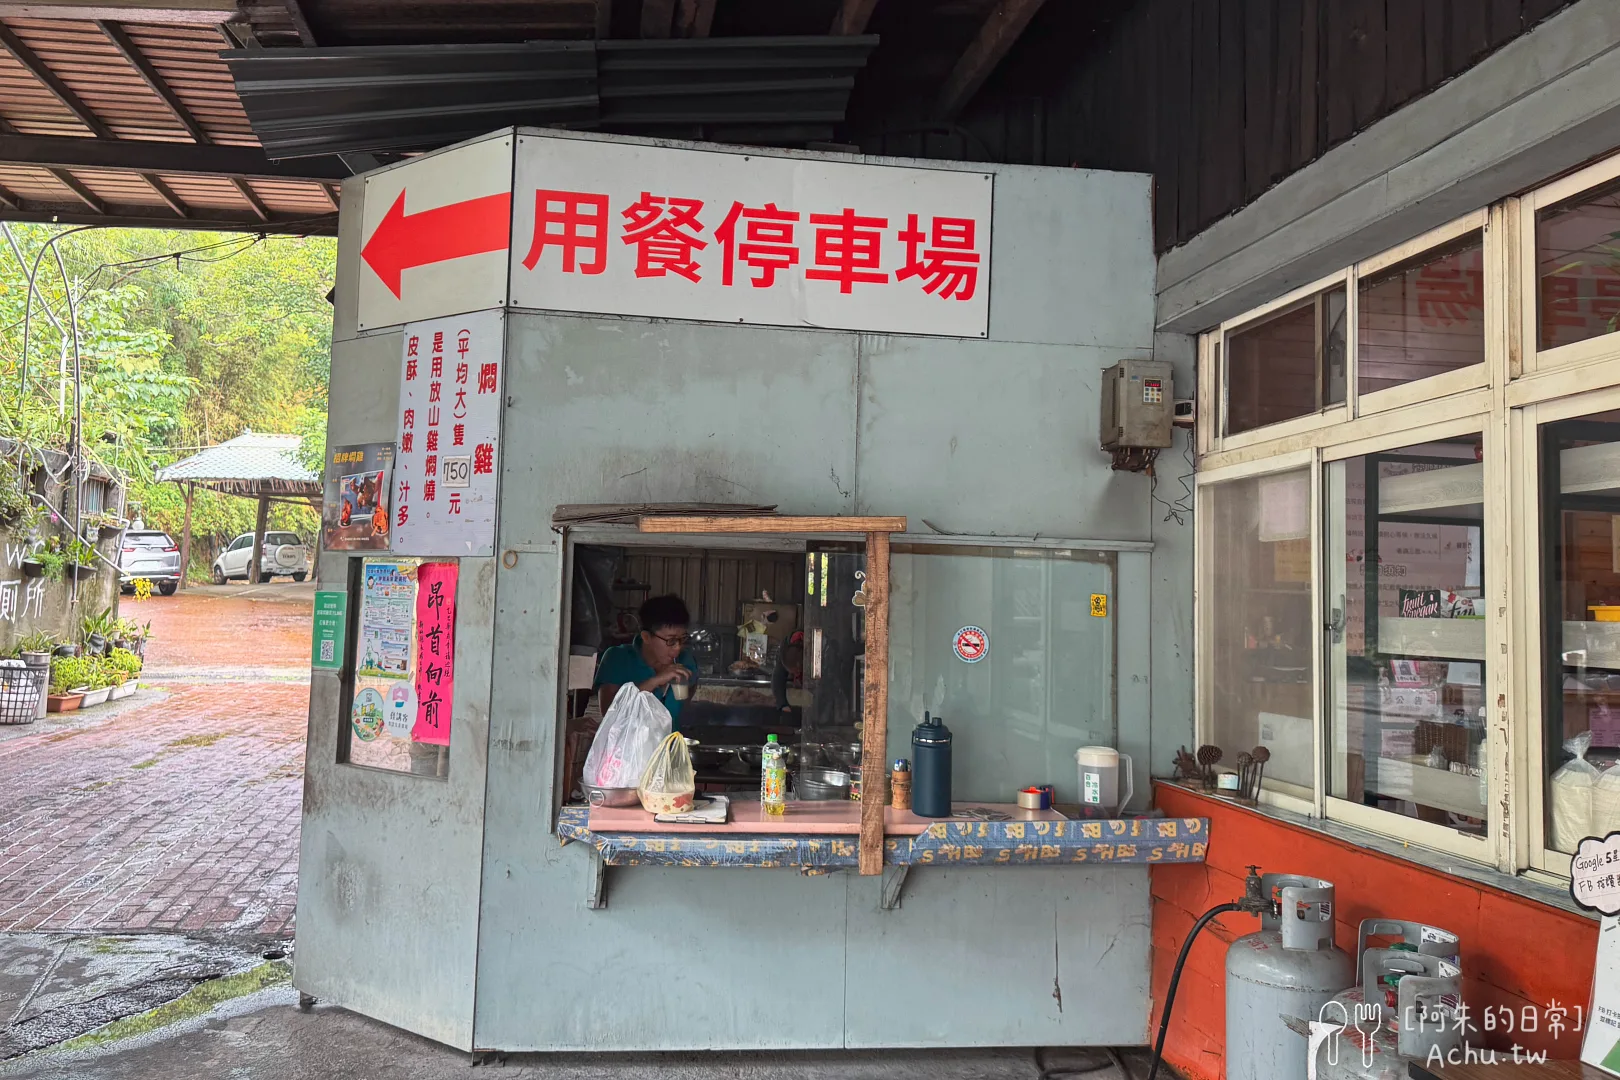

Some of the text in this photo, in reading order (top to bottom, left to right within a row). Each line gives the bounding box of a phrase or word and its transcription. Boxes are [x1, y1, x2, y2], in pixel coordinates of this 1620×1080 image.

[521, 188, 981, 302] 用餐停車場
[443, 461, 469, 482] 750
[448, 492, 461, 515] 元
[1402, 592, 1426, 614] fruit
[420, 581, 444, 729] 昂首向前
[1575, 854, 1604, 871] Google
[1578, 879, 1593, 893] FB
